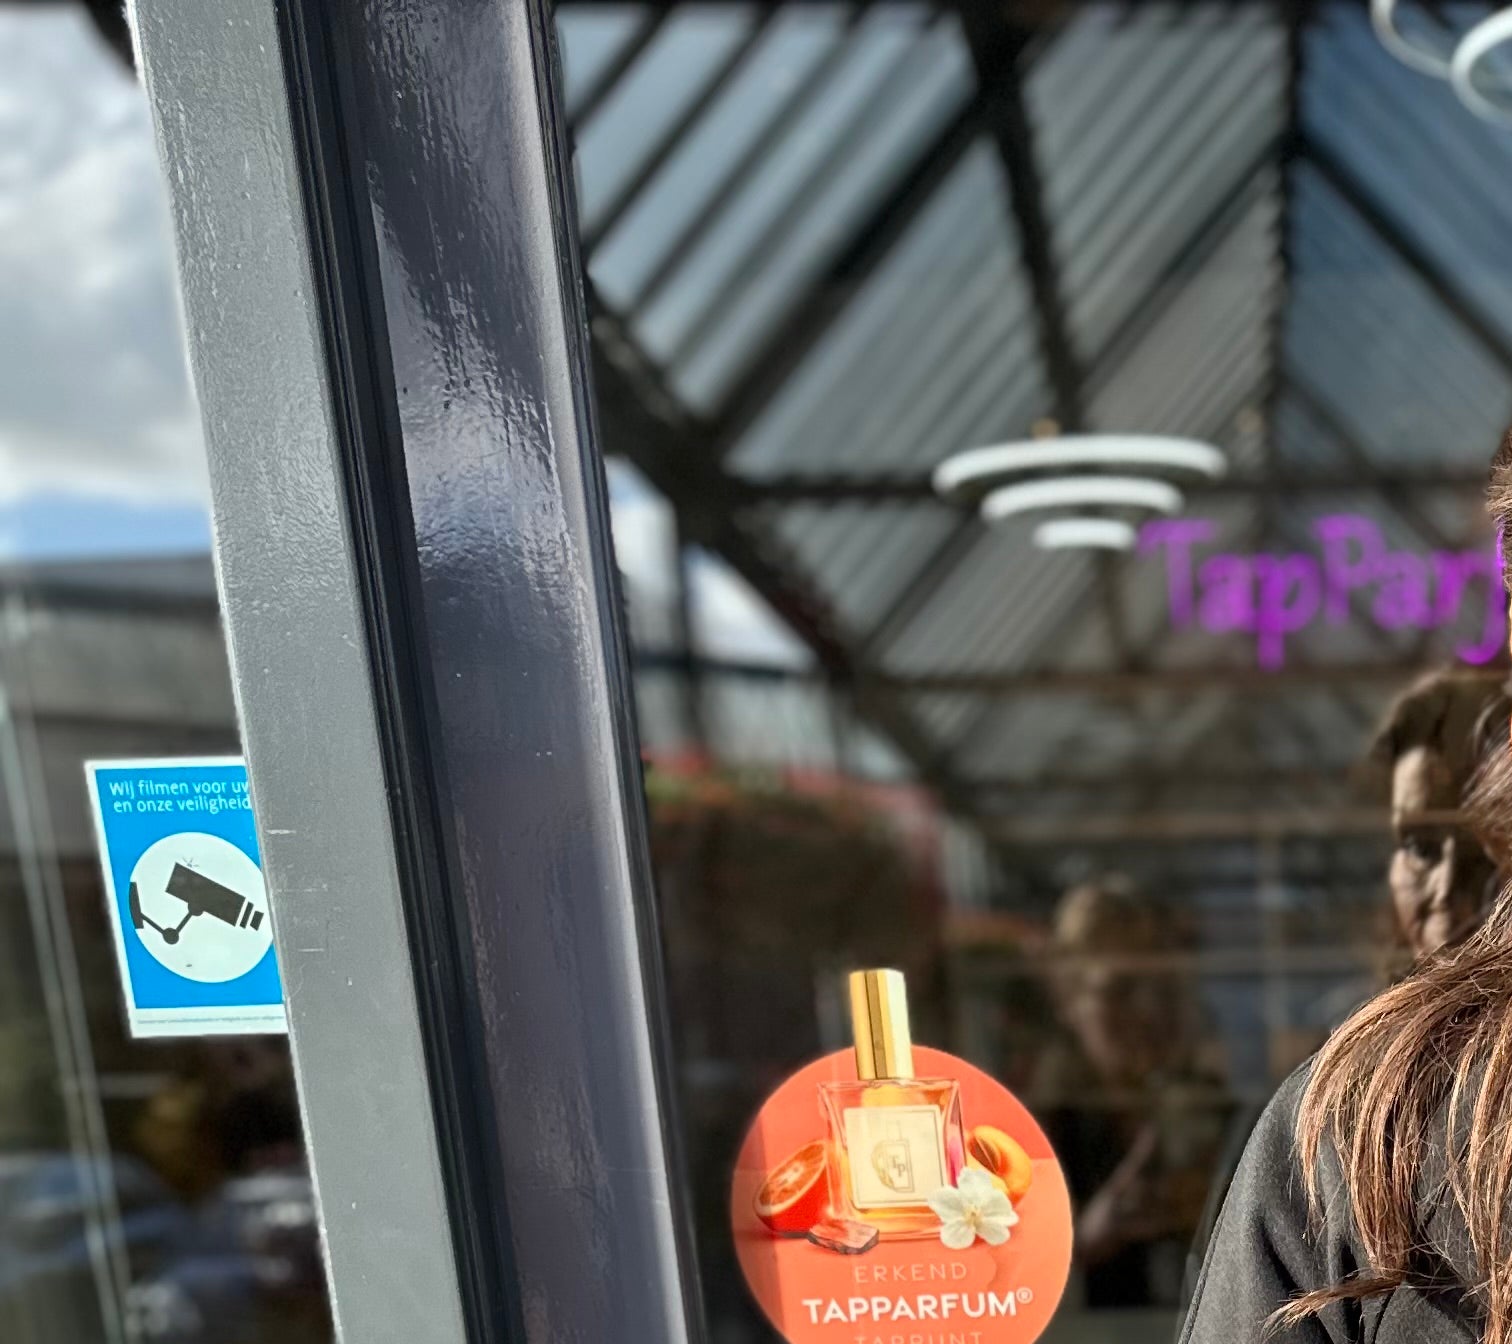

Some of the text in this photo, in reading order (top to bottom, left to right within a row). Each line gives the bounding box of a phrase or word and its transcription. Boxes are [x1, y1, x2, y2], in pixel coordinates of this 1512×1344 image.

[109, 780, 135, 800] Wij
[138, 779, 189, 796] filmen
[192, 781, 226, 795] voor
[113, 795, 252, 815] en onze veiligheid
[853, 1262, 968, 1284] ERKEND
